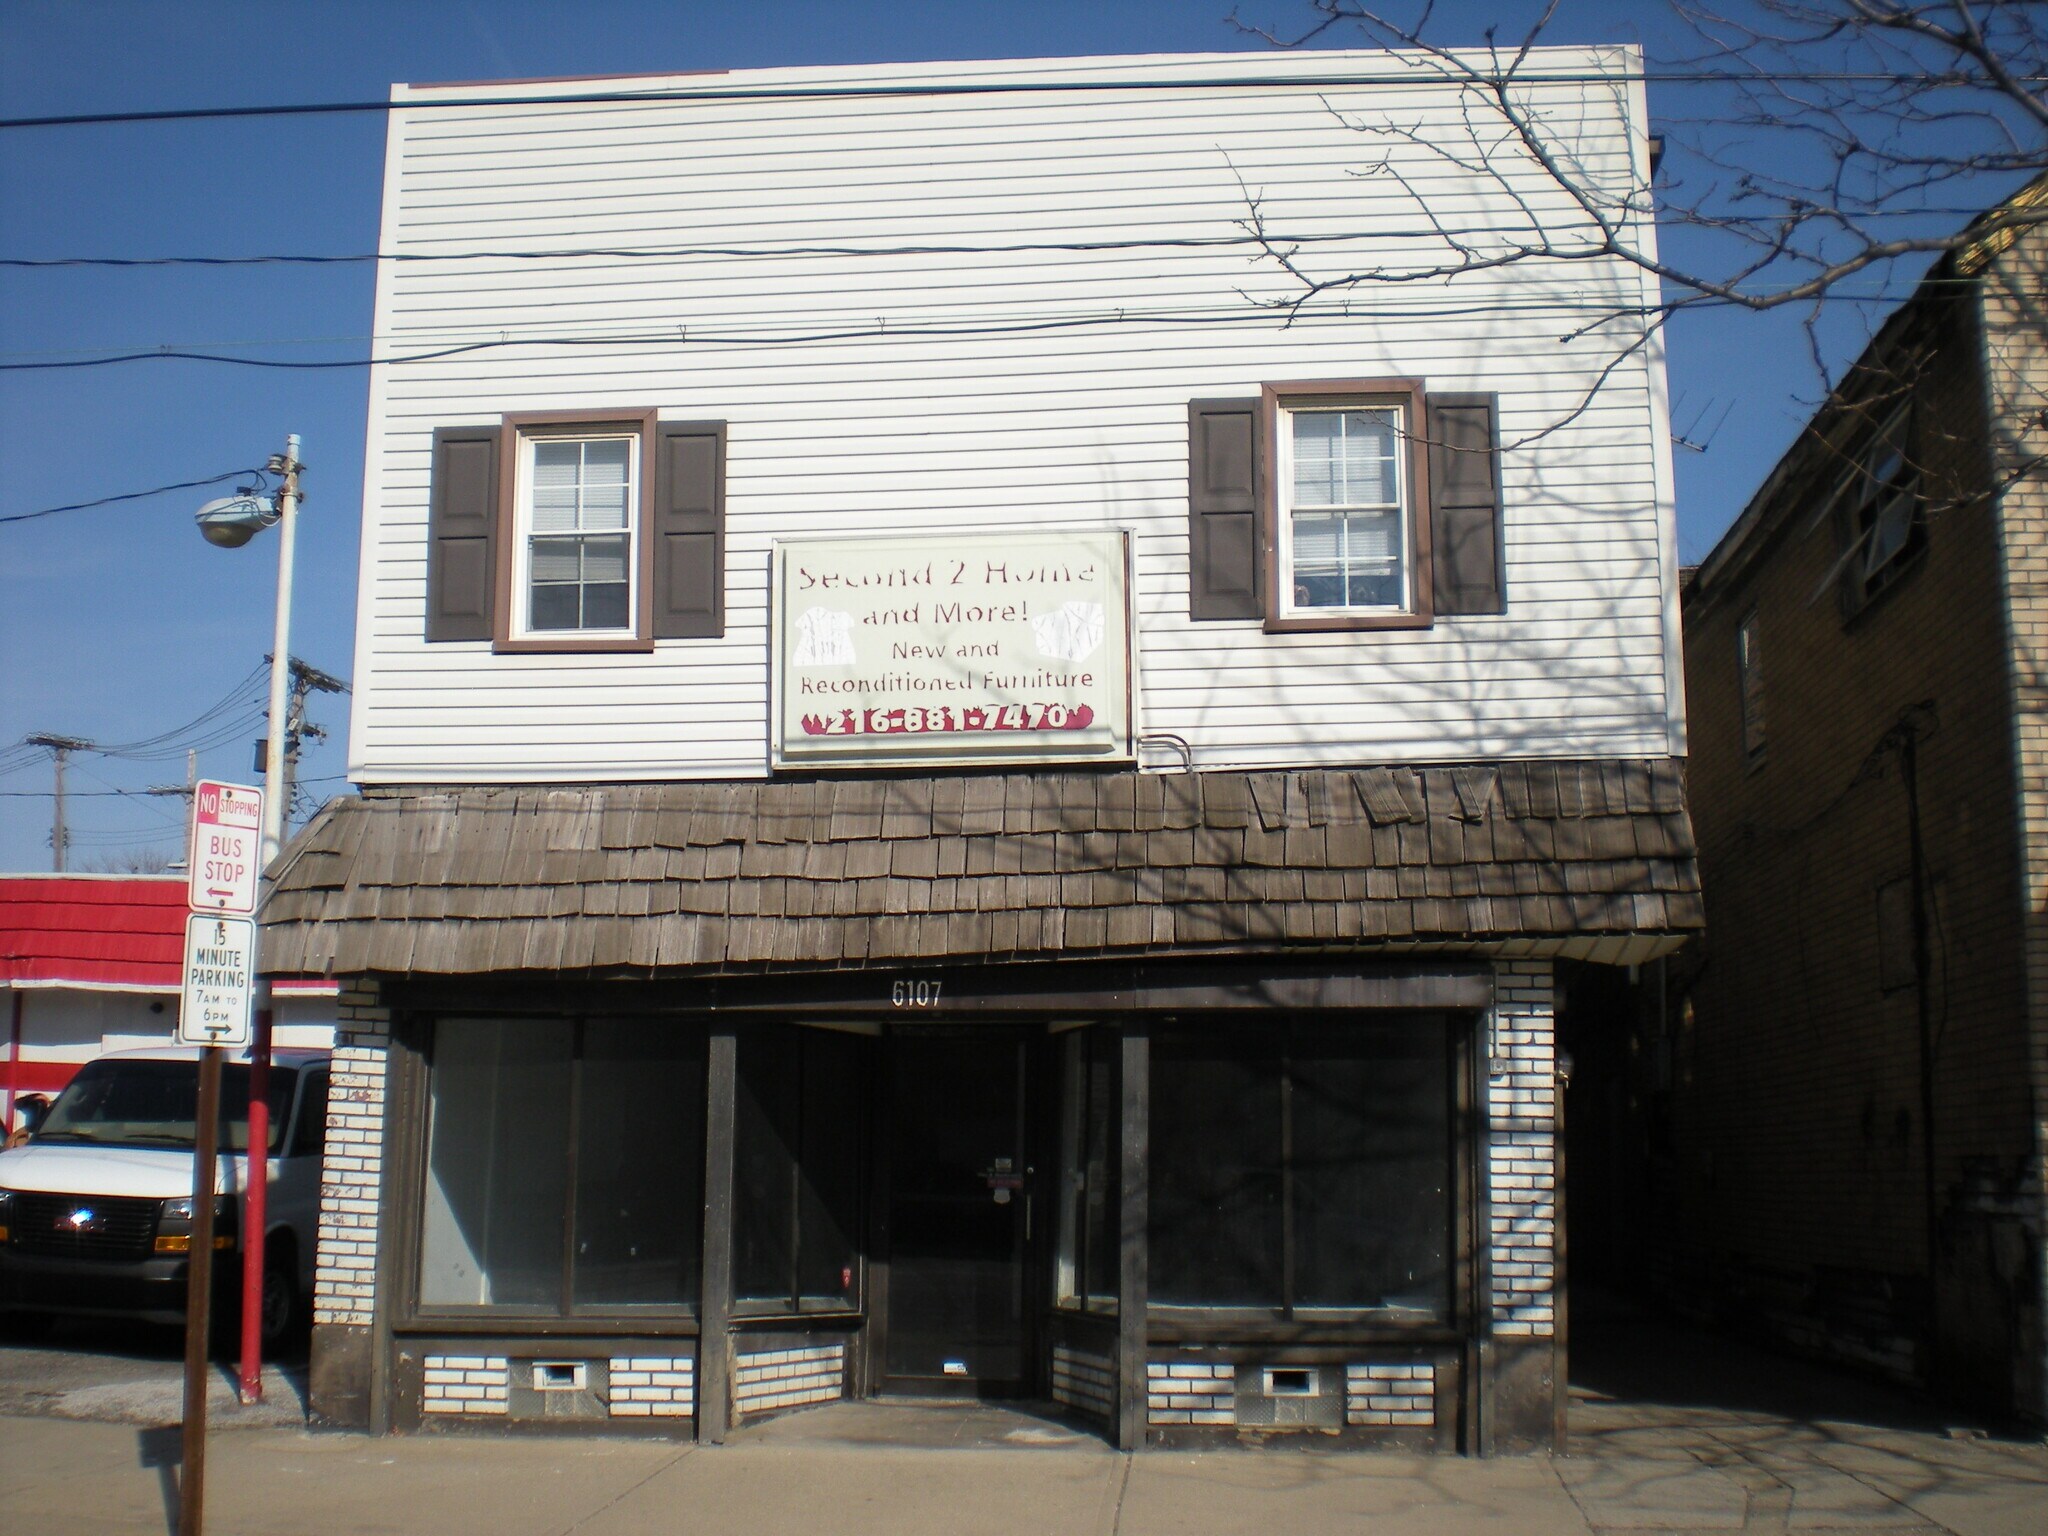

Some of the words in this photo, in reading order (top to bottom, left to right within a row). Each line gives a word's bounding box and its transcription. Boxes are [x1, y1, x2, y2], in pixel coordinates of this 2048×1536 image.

[863, 602, 919, 625] and
[935, 600, 1028, 623] More!
[892, 641, 946, 660] New
[957, 640, 999, 658] and
[801, 672, 972, 694] Reconditioned
[200, 793, 217, 815] NO
[220, 798, 258, 818] STOPPING
[210, 835, 242, 858] BUS
[205, 860, 245, 883] STOP
[213, 927, 226, 946] 15
[196, 948, 242, 967] MINUTE
[191, 968, 244, 989] PARKING
[196, 989, 220, 1005] 7AM
[226, 996, 238, 1006] TO
[892, 980, 942, 1007] 6107
[203, 1007, 229, 1021] 6PM
